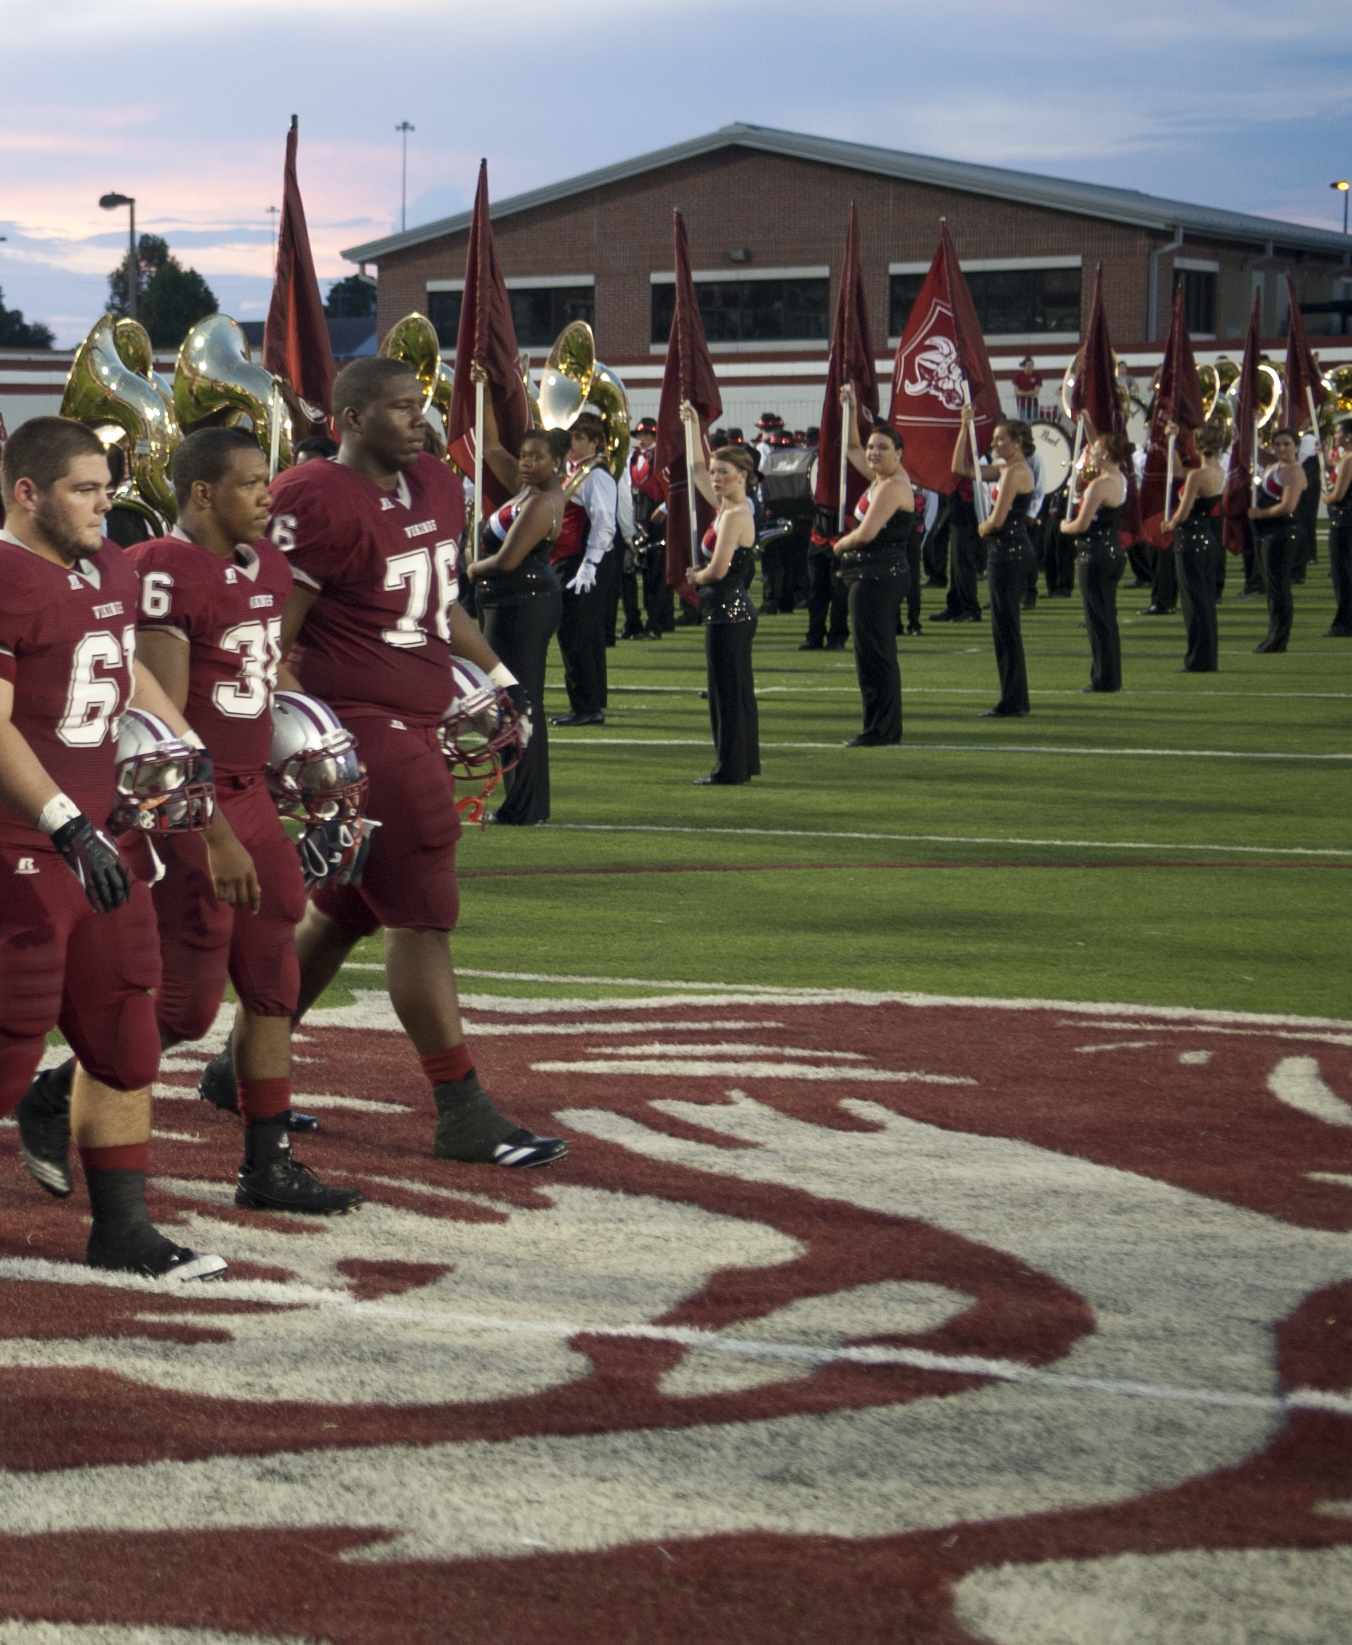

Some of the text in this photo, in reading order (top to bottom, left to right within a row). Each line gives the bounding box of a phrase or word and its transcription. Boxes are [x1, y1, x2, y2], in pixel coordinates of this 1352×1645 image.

[267, 513, 298, 551] 6
[404, 519, 437, 538] VIKINGS
[134, 570, 174, 619] 6
